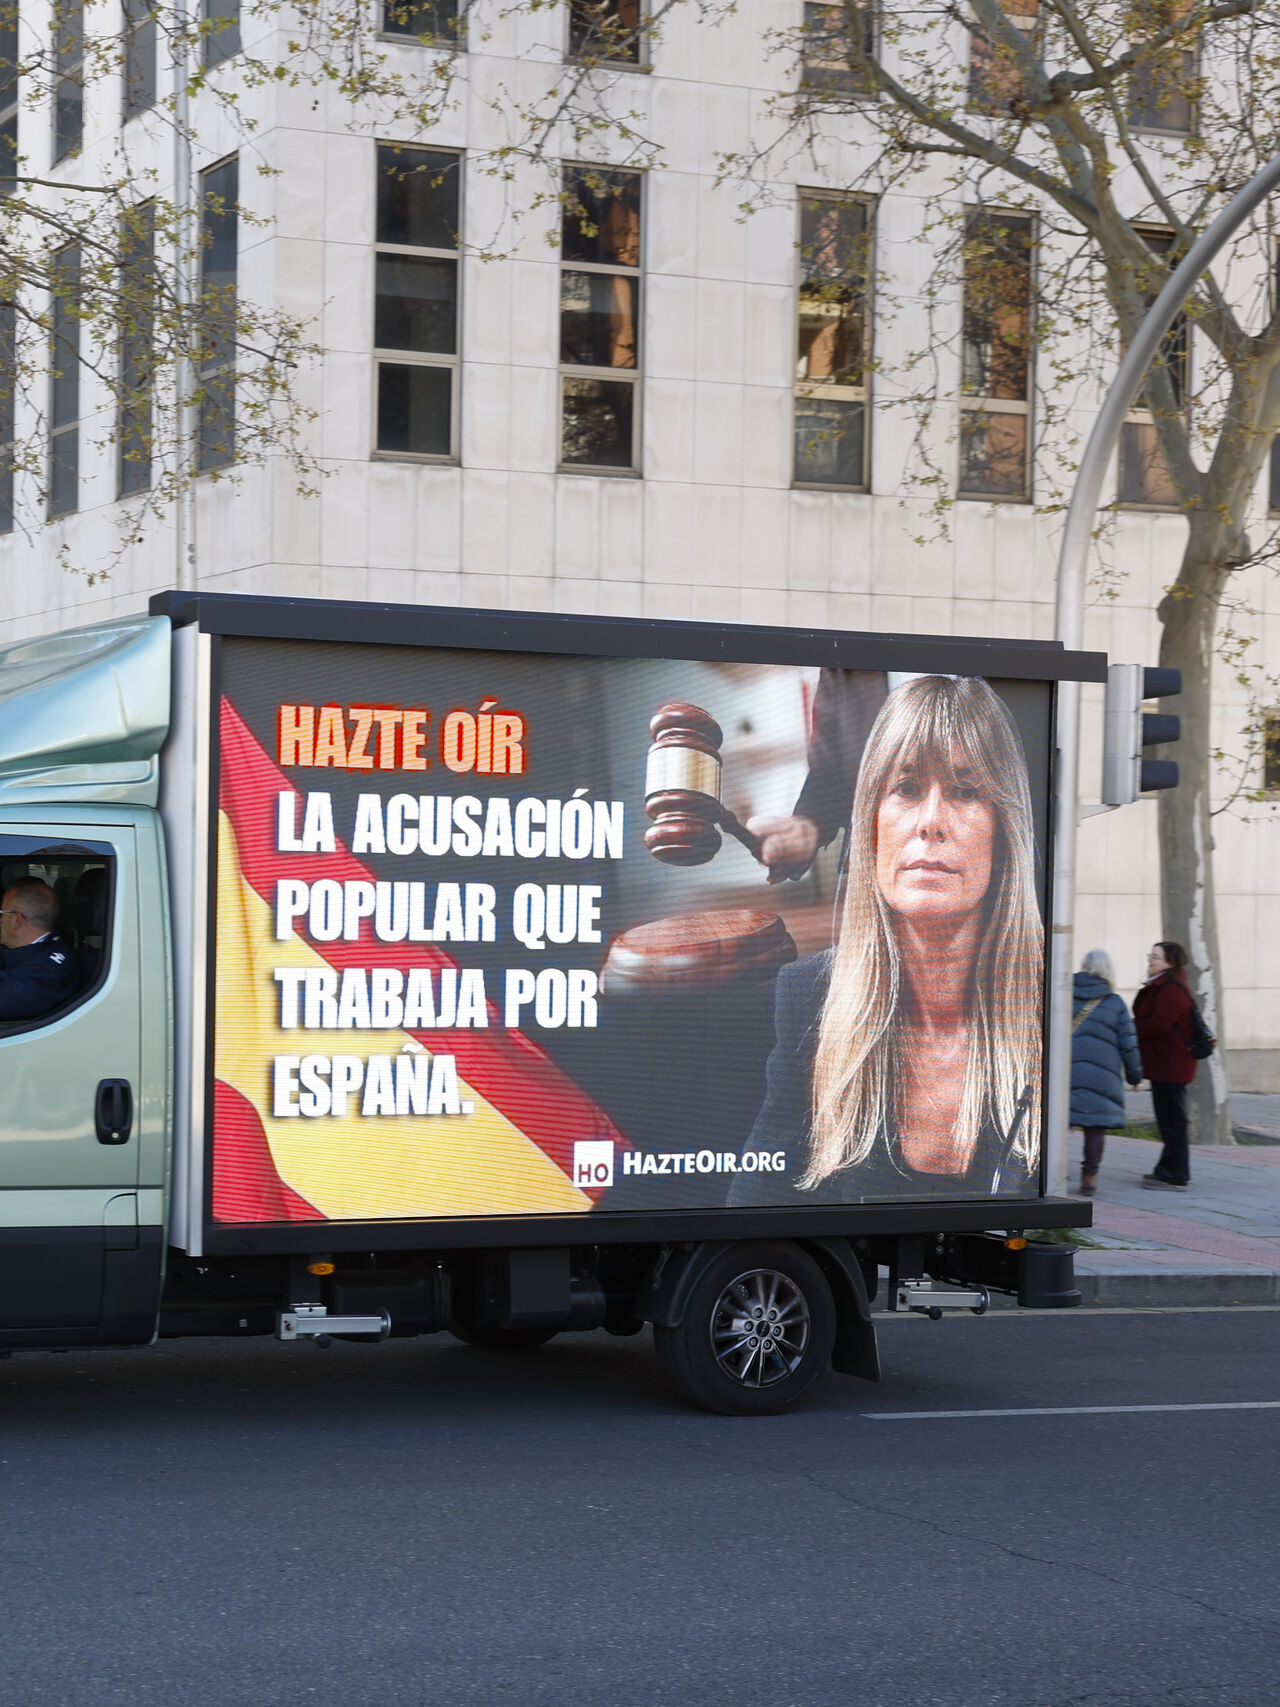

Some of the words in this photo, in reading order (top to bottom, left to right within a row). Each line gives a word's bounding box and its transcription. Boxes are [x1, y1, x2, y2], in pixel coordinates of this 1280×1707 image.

[278, 704, 427, 770] HAZTE
[442, 700, 524, 773] OÍR
[277, 790, 336, 853] LA
[352, 788, 624, 859] ACUSACIÓN
[275, 879, 496, 942] POPULAR
[512, 883, 602, 949] QUE
[273, 967, 488, 1029] TRABAJA
[504, 969, 598, 1028] POR
[272, 1043, 475, 1118] ESPAÑA.
[578, 1163, 609, 1183] HO
